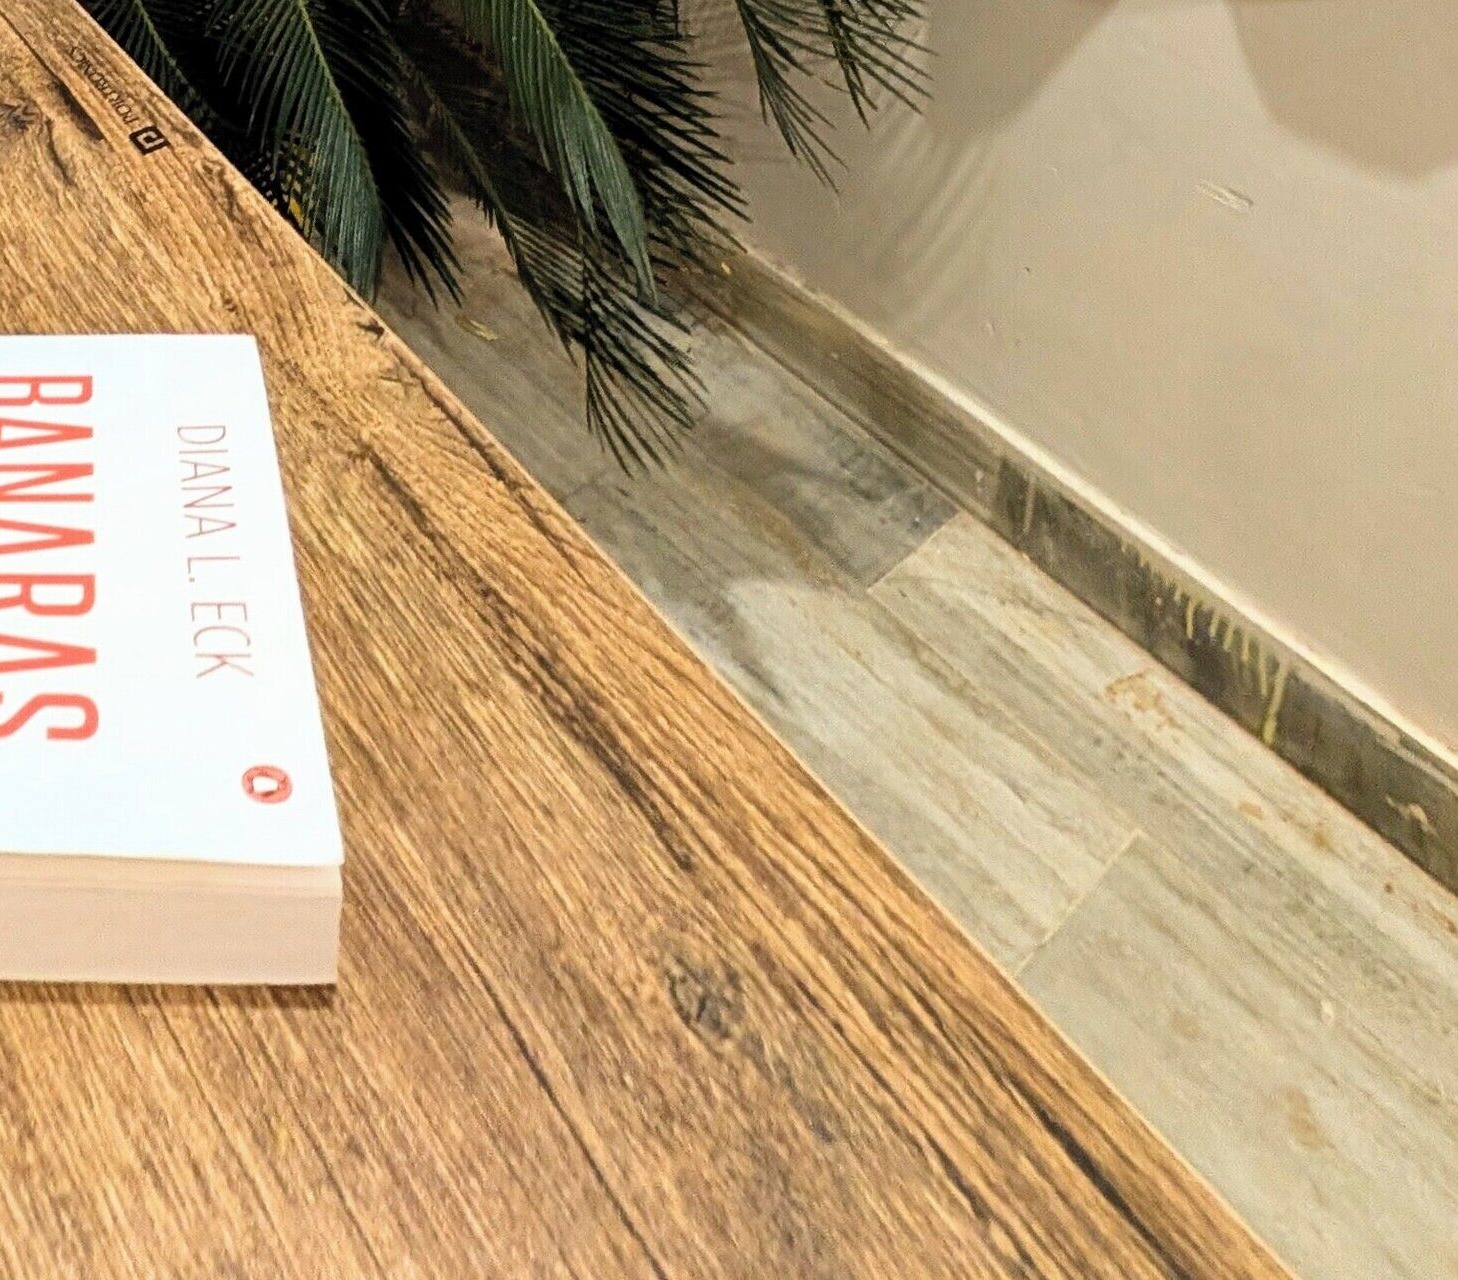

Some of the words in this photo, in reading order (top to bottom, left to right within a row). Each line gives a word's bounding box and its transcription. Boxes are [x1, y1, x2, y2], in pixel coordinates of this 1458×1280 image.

[176, 424, 238, 540] DIANA
[186, 555, 241, 584] L.
[190, 602, 255, 679] ECK
